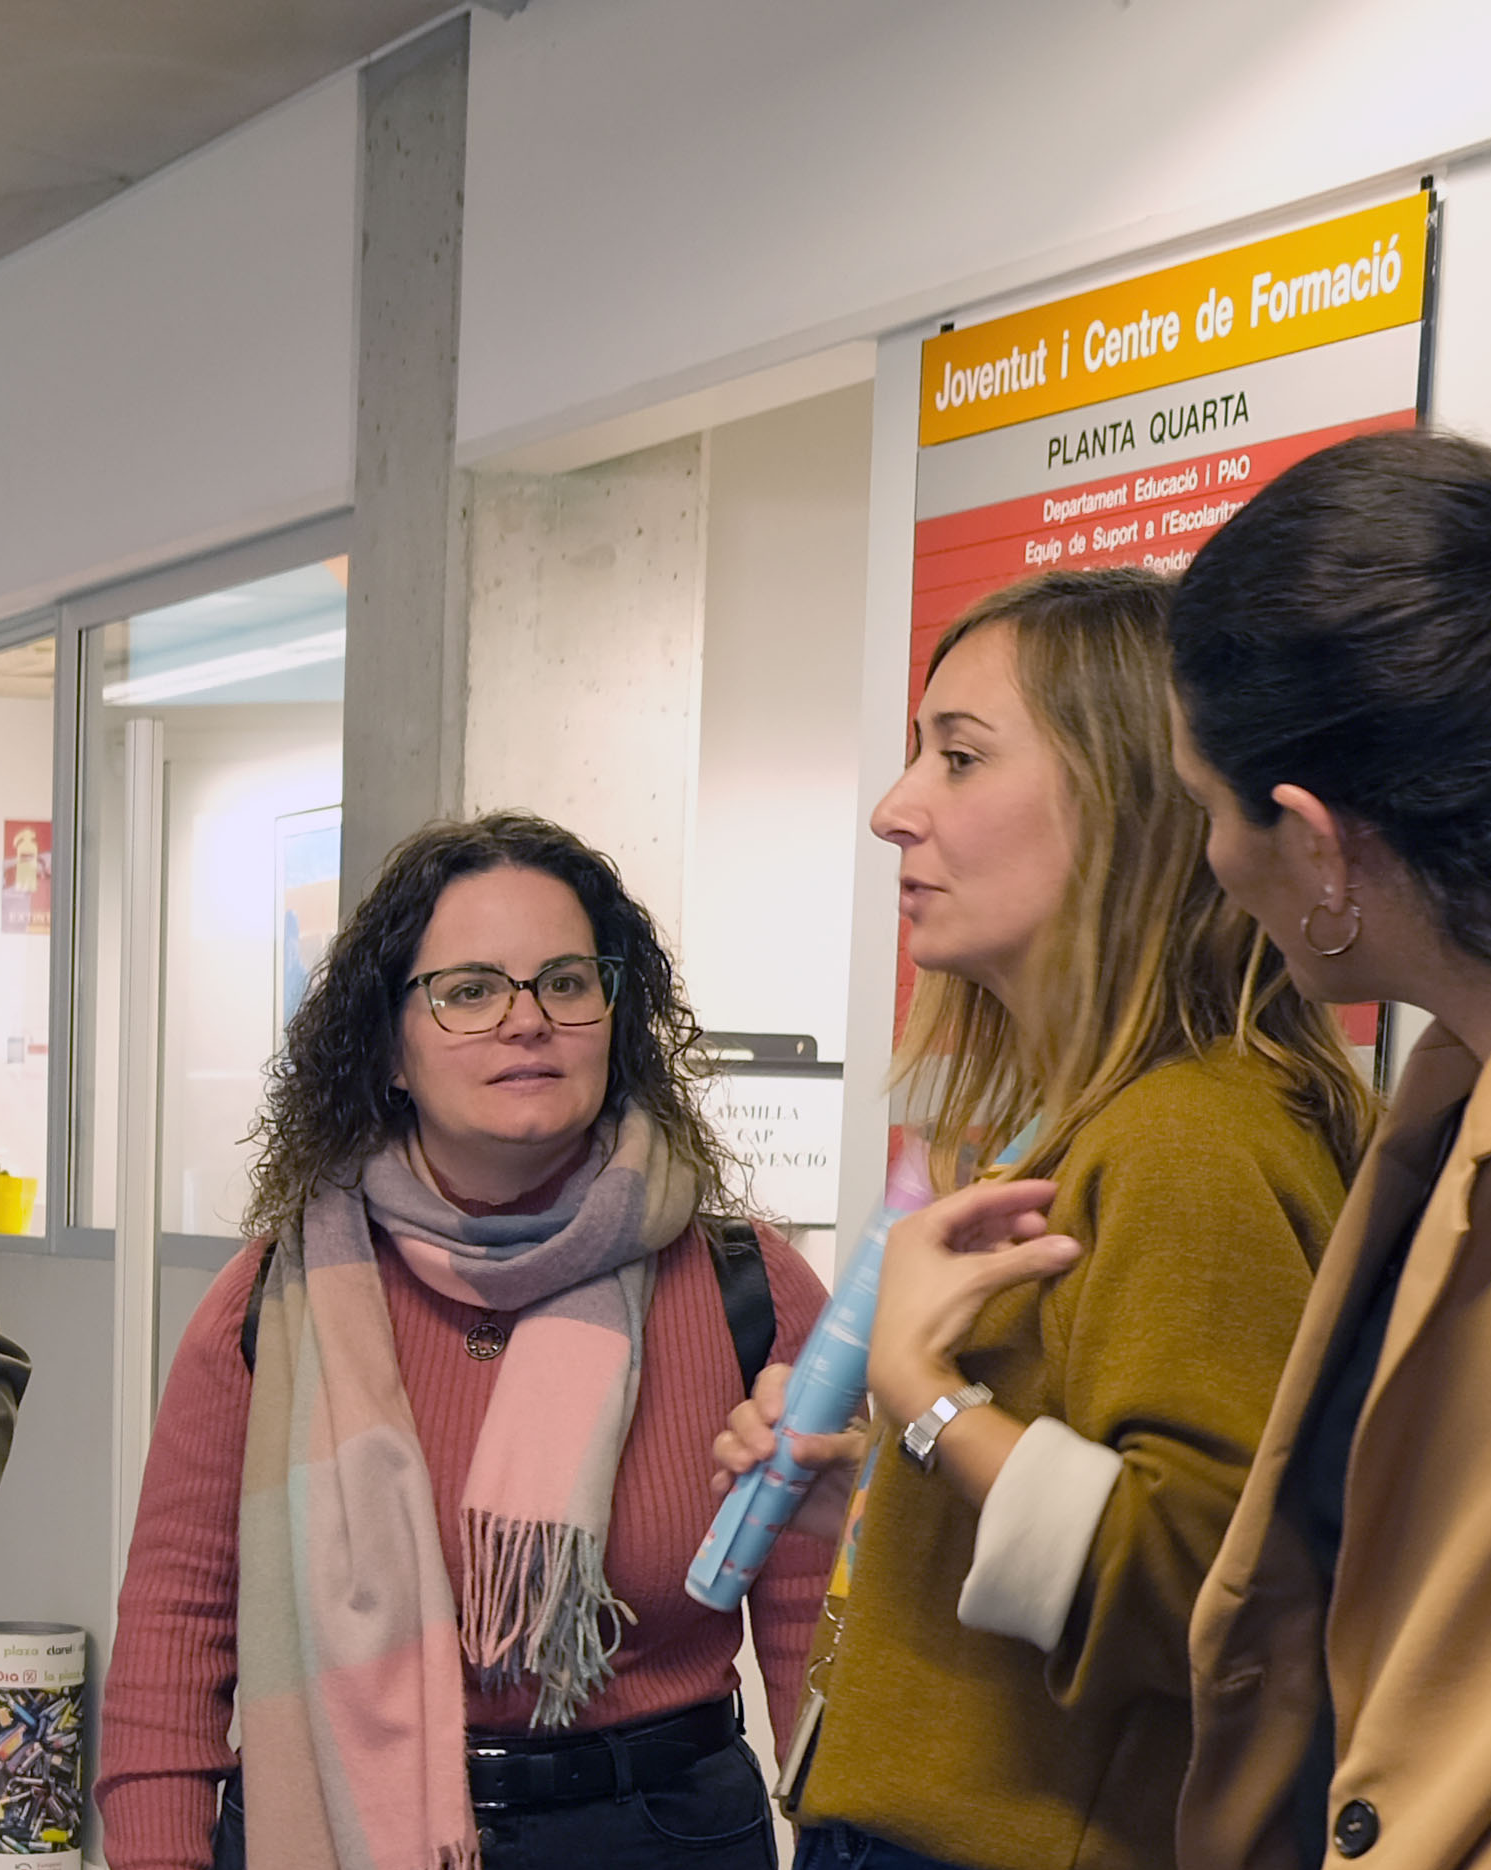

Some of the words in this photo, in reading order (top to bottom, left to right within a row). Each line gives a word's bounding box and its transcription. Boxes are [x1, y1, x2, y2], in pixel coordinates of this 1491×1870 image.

[935, 338, 1046, 410] Joventut
[1060, 330, 1069, 379] i
[1083, 310, 1180, 373] Centre
[1195, 288, 1233, 342] de
[1250, 235, 1402, 329] Formació
[1048, 421, 1136, 469] PLANTA
[1149, 391, 1249, 445] QUARTA
[1043, 484, 1128, 524] Departament
[1134, 466, 1198, 502] Educació
[1205, 463, 1211, 487] i
[1218, 455, 1251, 485] PAO
[1025, 541, 1062, 568] Equip
[1069, 533, 1086, 556] de
[1093, 521, 1139, 552] Suport
[1145, 520, 1155, 540] a
[1161, 500, 1250, 536] l'Escolaritz
[716, 1104, 799, 1121] ARMILLA
[737, 1127, 774, 1144] CAP
